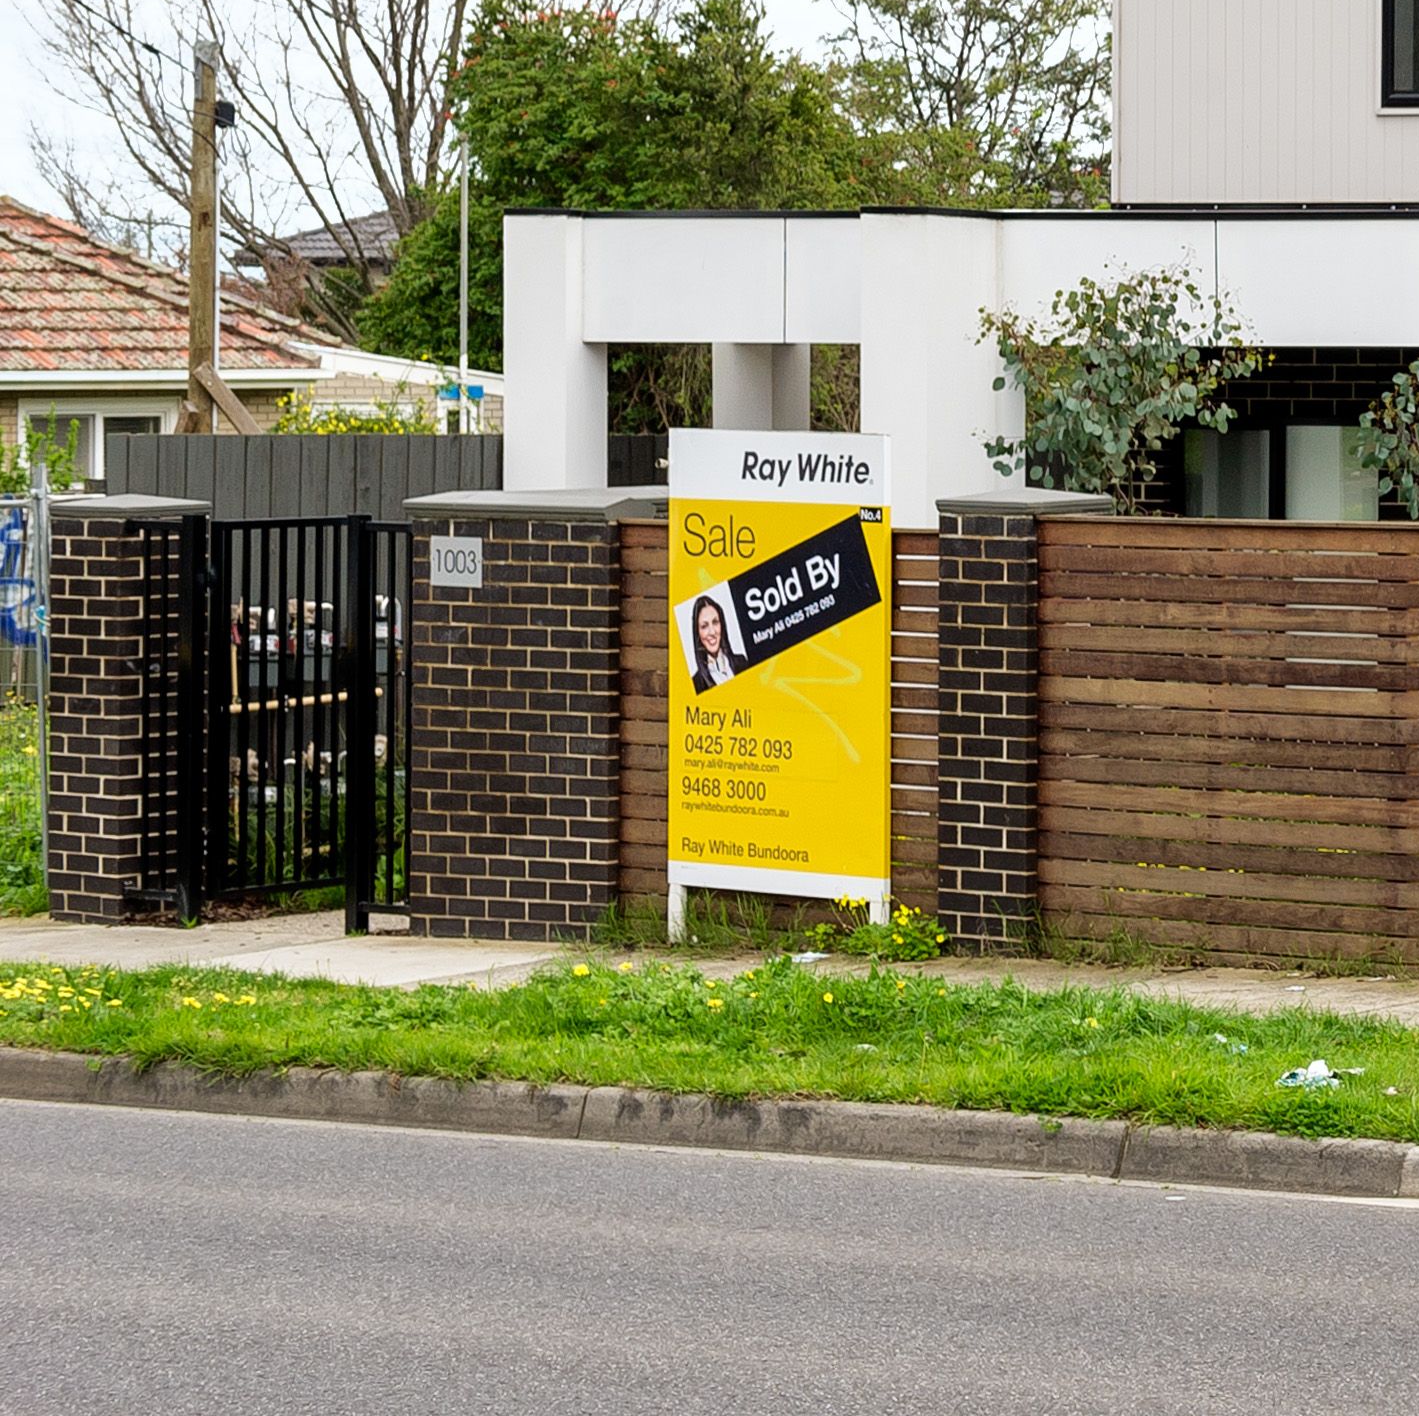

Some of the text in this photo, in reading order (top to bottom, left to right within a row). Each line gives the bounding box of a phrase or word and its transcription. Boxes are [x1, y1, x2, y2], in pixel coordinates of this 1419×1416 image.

[741, 451, 792, 487] Ray
[683, 512, 755, 559] Sale
[436, 549, 477, 574] 1003
[745, 553, 840, 621] Sold By
[753, 627, 774, 644] Mary
[774, 619, 786, 634] Ali
[685, 705, 752, 732] Mary Ali
[684, 733, 793, 760] 0425 782 093
[682, 775, 766, 801] 9468 3000
[682, 837, 810, 863] Ray White Bundoora
